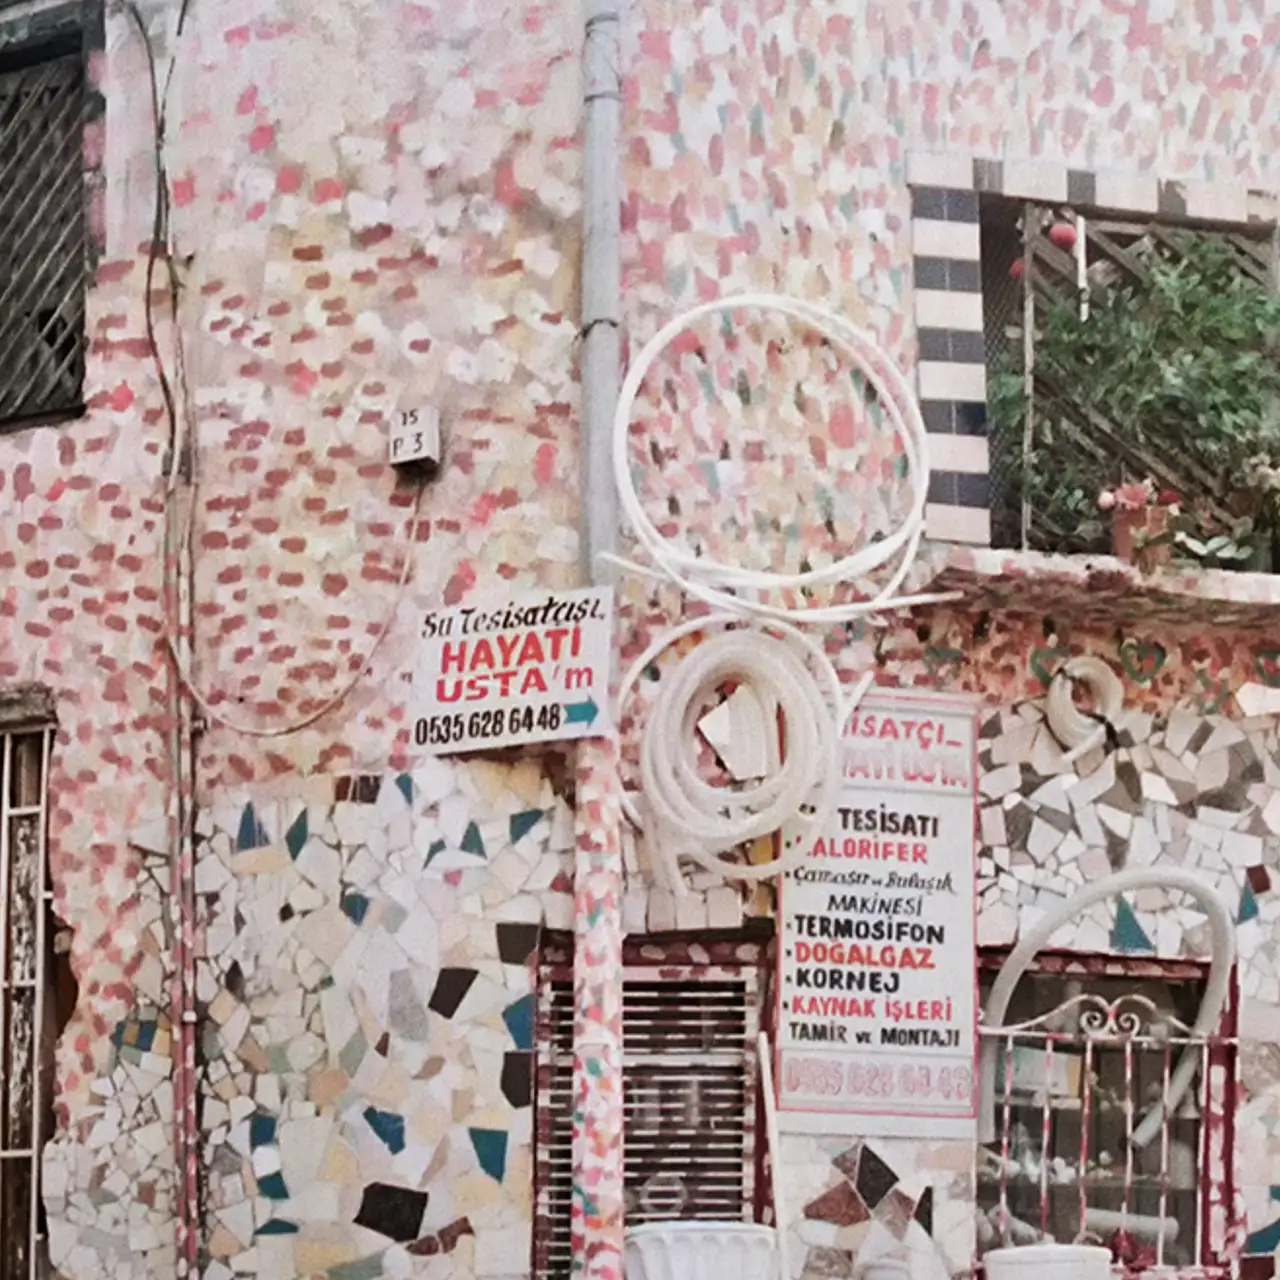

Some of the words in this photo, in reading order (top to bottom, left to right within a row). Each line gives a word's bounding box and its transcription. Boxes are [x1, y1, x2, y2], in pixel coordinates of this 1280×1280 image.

[422, 611, 453, 638] Su
[441, 620, 582, 675] HAYATİ
[436, 665, 594, 703] USTA'm
[415, 713, 465, 745] 0535
[468, 708, 505, 738] 628
[509, 706, 534, 734] 64
[537, 703, 560, 730] 48
[837, 803, 940, 838] TESİSATI
[796, 833, 928, 865] ALORİFER
[794, 914, 945, 944] TERMOSİFON
[794, 938, 936, 970] DOĞALGAZ
[796, 968, 901, 994] KORNEJ
[791, 994, 877, 1019] KAYNAK
[884, 995, 953, 1023] İŞLERİ
[788, 1020, 848, 1044] TAMİR
[880, 1027, 961, 1047] MONTAJI
